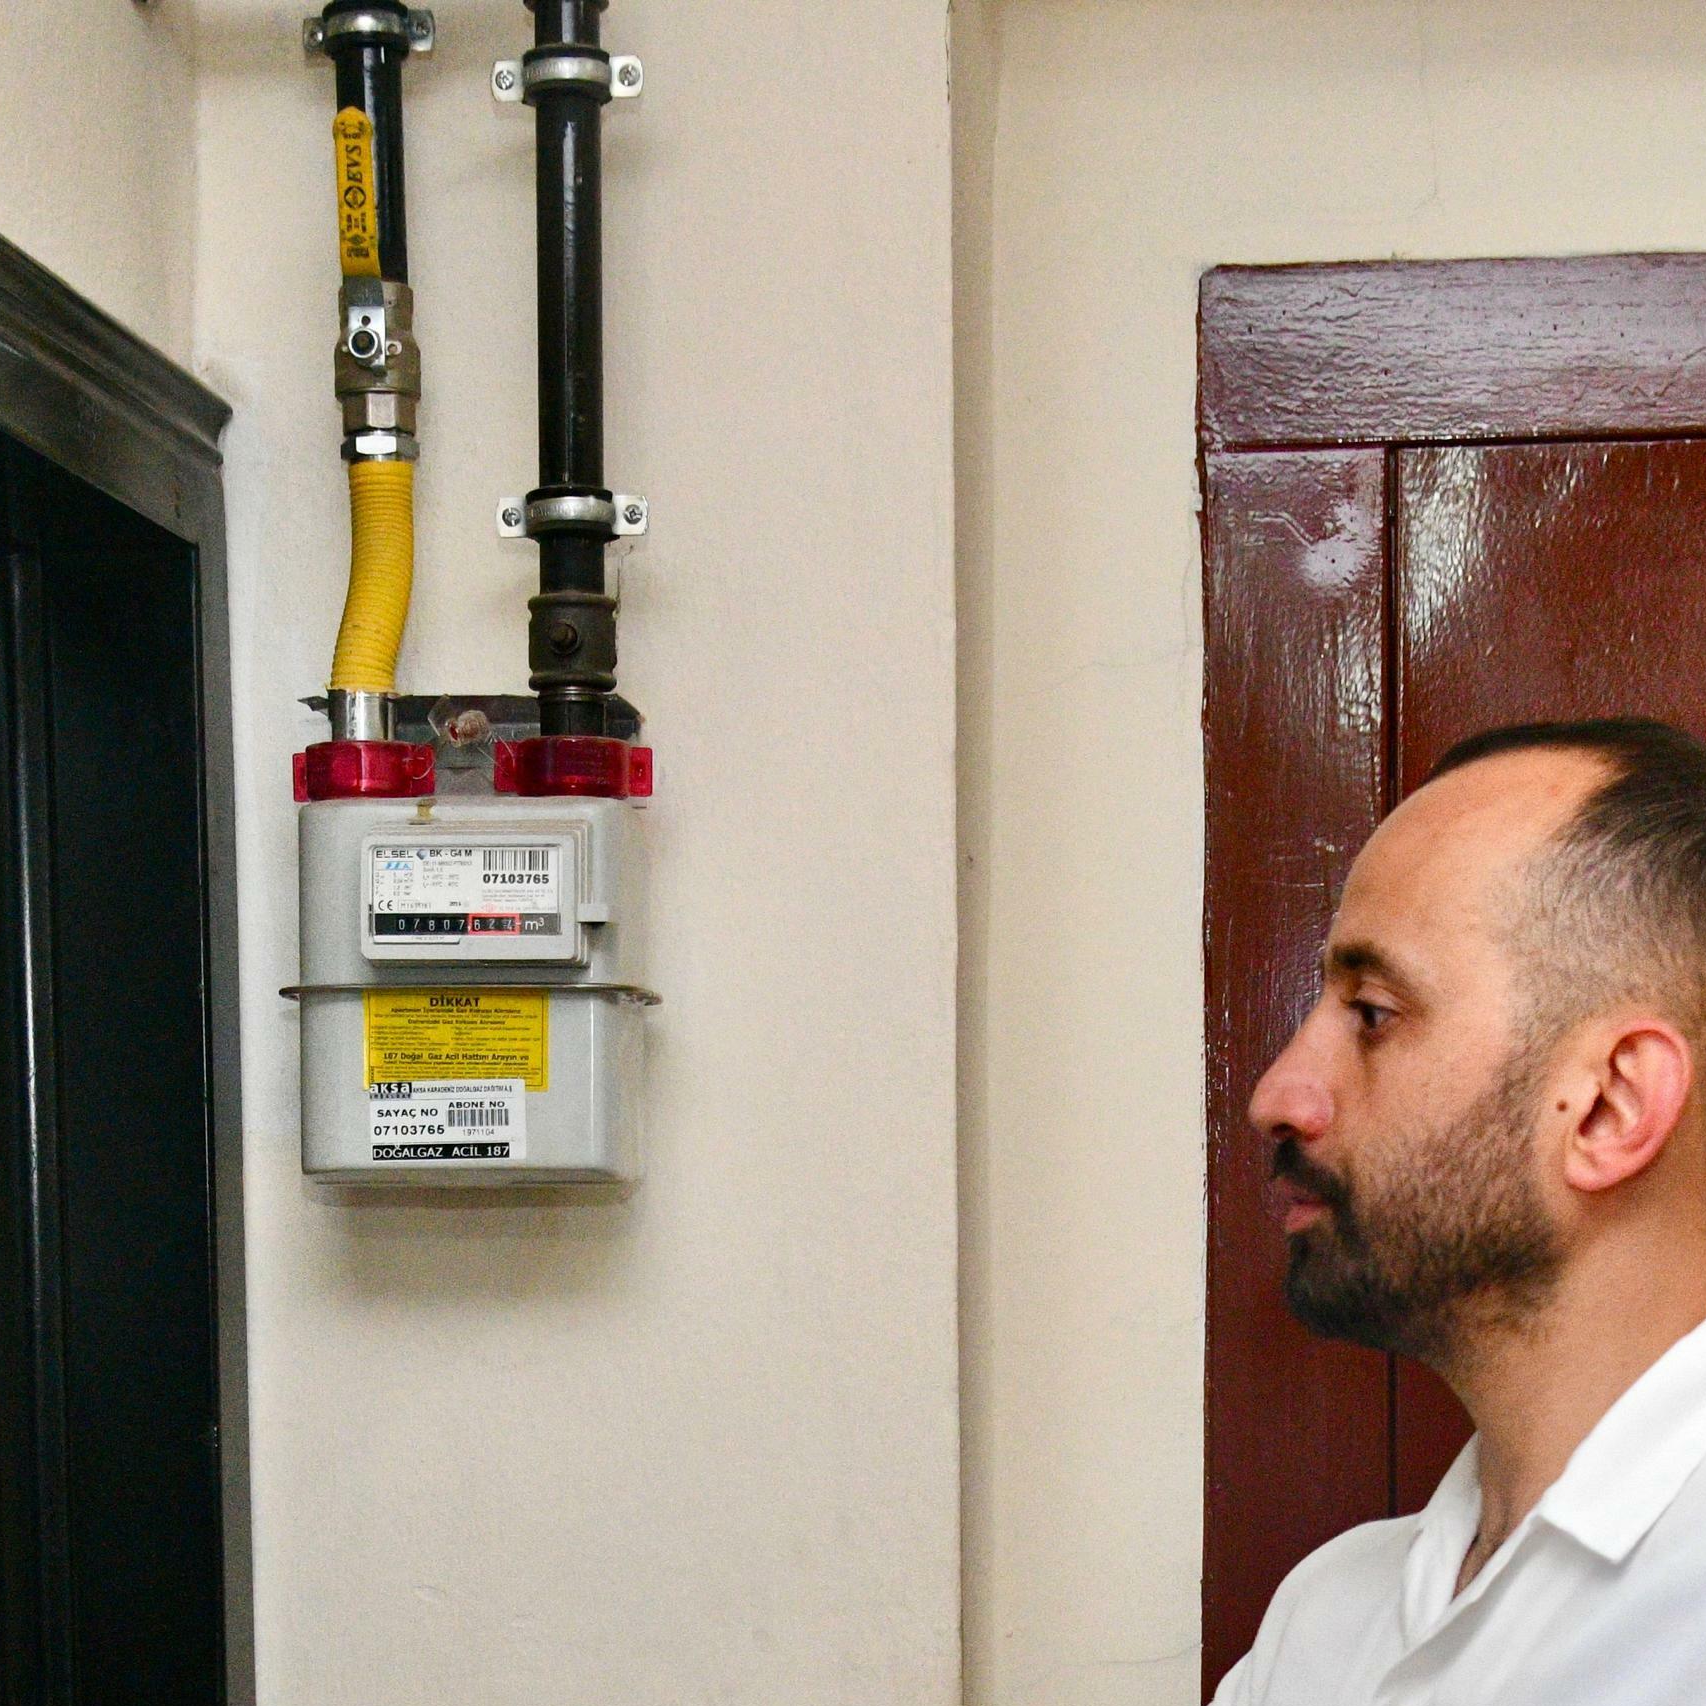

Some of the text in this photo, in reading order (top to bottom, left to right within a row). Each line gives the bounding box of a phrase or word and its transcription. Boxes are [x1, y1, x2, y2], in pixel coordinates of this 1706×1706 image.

[345, 144, 363, 184] EVS
[376, 850, 414, 858] ELSEL
[429, 849, 442, 857] BK
[450, 849, 462, 857] G4
[482, 873, 550, 884] 07103765
[429, 994, 480, 1007] DİKKAT
[427, 1052, 443, 1060] Gaz
[445, 1052, 460, 1060] Acil
[371, 1083, 410, 1094] aksa
[448, 1101, 485, 1109] ABONE
[377, 1108, 439, 1119] SAYAÇ NO
[373, 1124, 444, 1136] 07103765
[462, 1128, 495, 1136] 1971104
[373, 1145, 510, 1159] DOĞALGAZ ACİL 187
